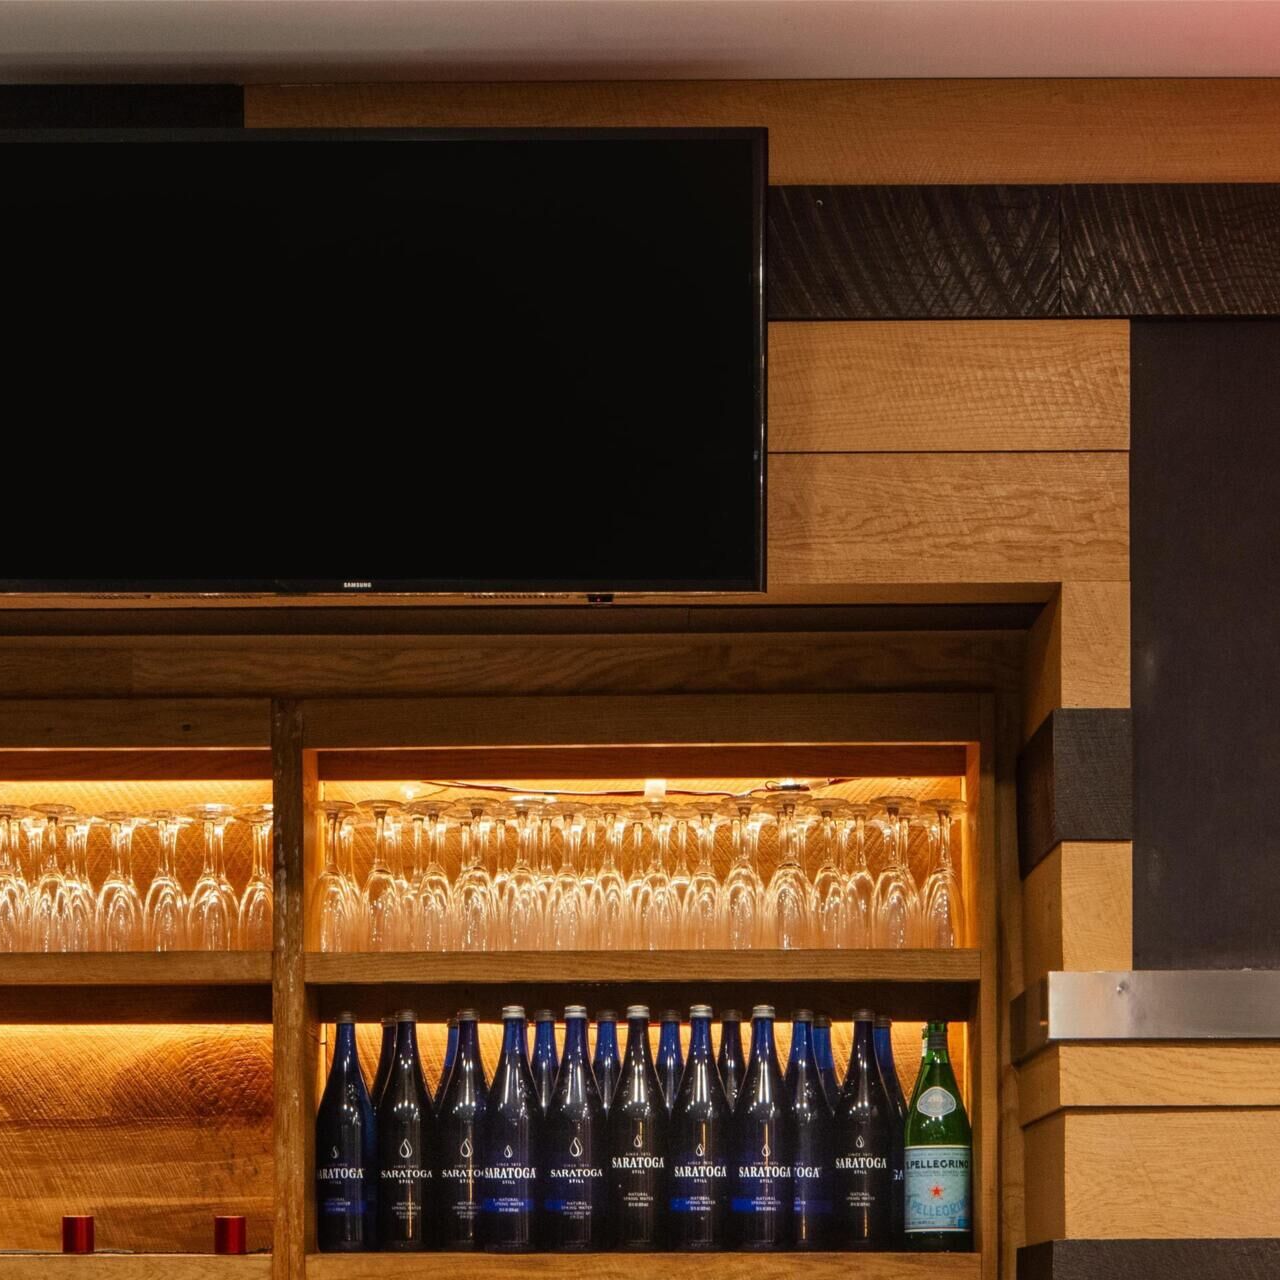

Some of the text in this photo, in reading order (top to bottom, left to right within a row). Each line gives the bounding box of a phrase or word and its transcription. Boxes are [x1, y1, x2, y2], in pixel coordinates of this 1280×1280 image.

[612, 1157, 664, 1168] SARATOGA
[835, 1157, 887, 1168] SARATOGA
[381, 1170, 432, 1178] SARATOGA
[485, 1167, 536, 1178] SARATOGA
[550, 1169, 602, 1178] SARATOGA
[675, 1166, 727, 1177] SARATOGA
[739, 1166, 791, 1177] SARATOGA
